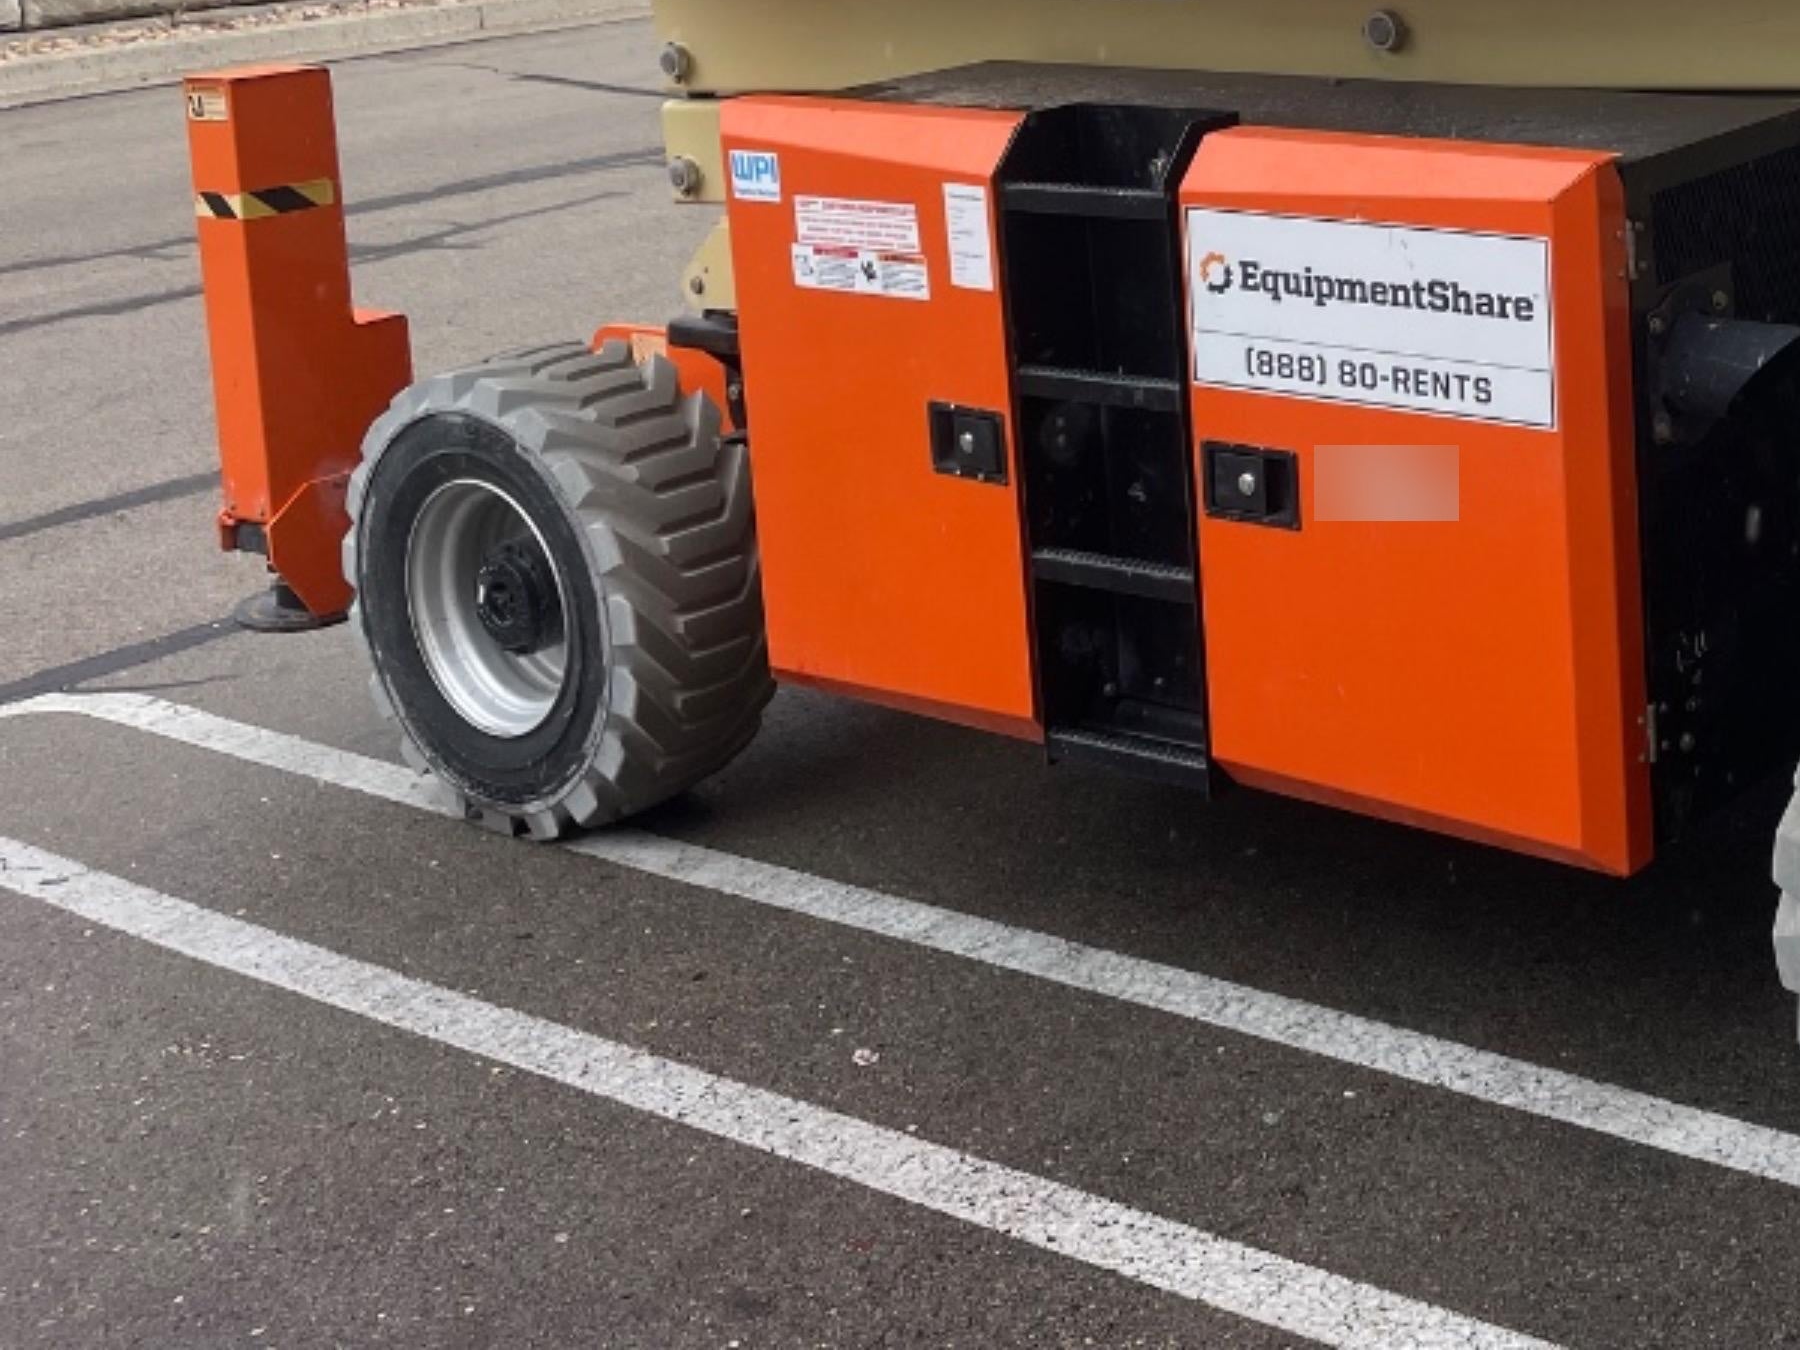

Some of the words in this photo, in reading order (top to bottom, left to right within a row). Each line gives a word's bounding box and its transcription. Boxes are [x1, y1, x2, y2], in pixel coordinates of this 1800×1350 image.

[1238, 260, 1535, 322] EquipmentShare
[1245, 347, 1327, 386] (888)
[1338, 358, 1493, 404] 80-RENTS
